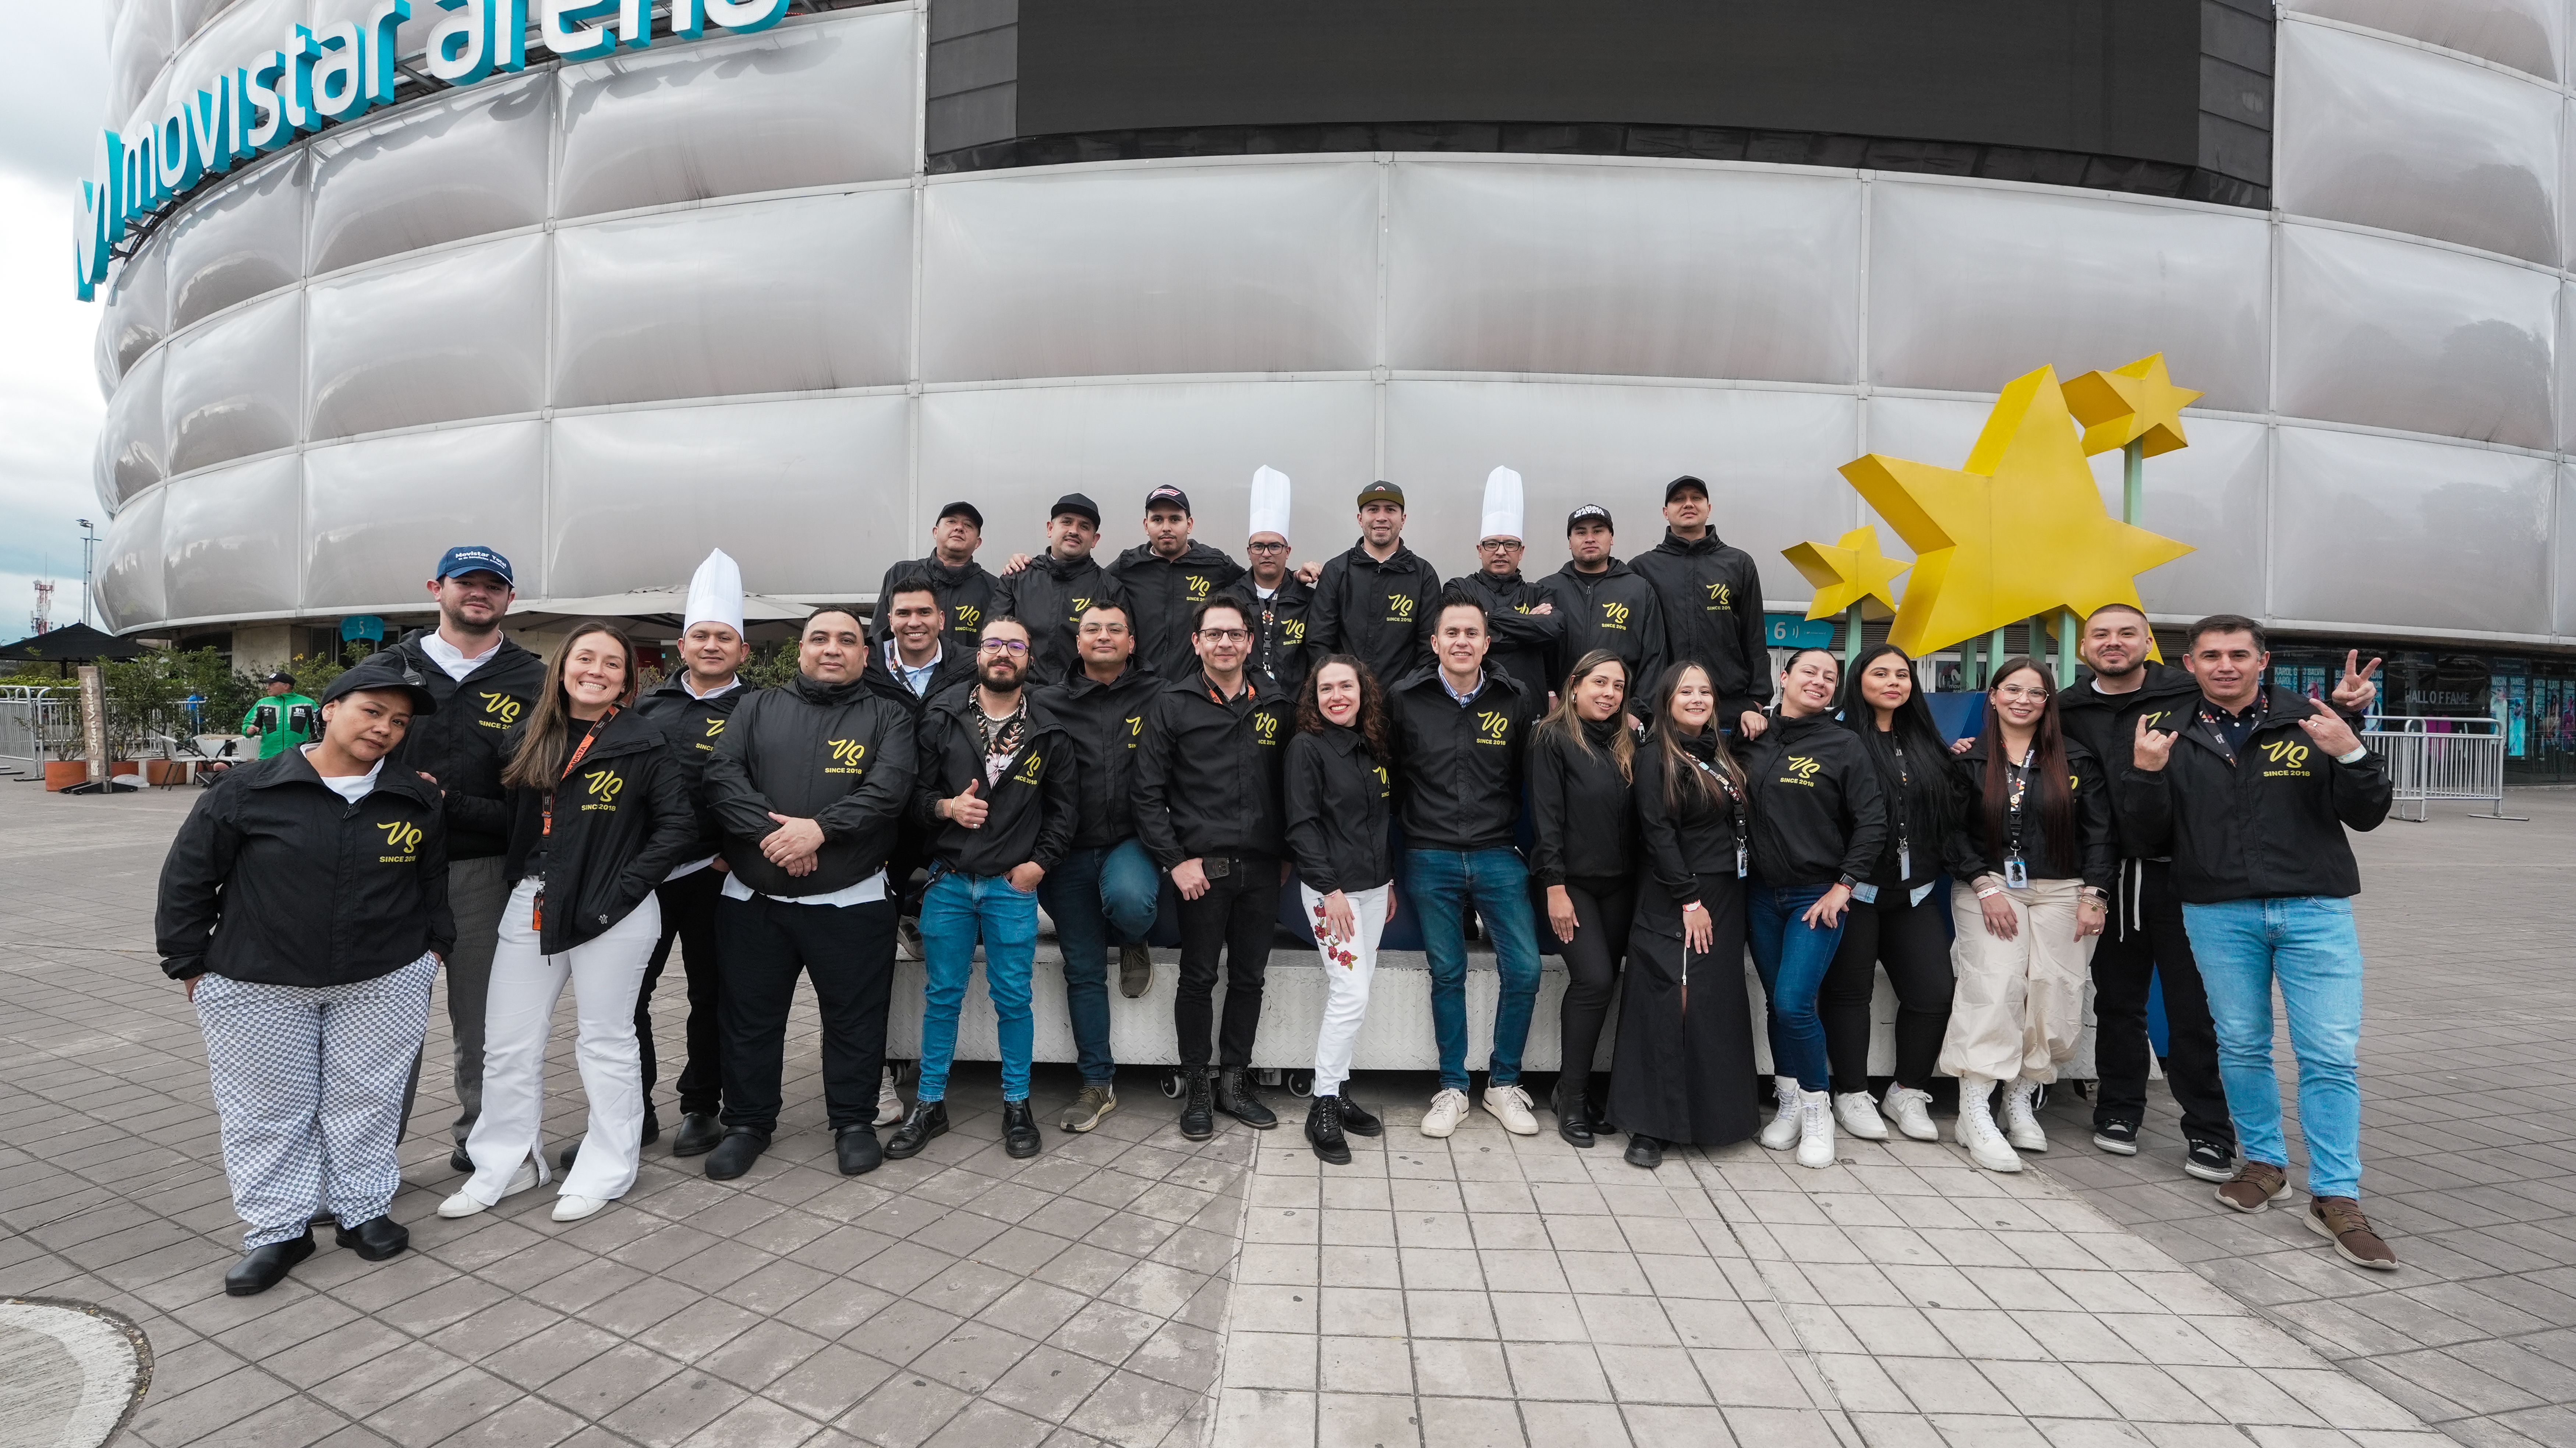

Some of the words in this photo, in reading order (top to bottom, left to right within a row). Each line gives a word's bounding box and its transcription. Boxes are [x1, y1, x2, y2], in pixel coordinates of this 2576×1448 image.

[121, 0, 411, 222] movistar
[492, 555, 507, 568] Total
[1185, 575, 1210, 597] VS
[1706, 583, 1730, 604] VS
[955, 605, 980, 626] VS
[1072, 597, 1090, 612] V
[1388, 594, 1413, 617] VS
[1602, 602, 1629, 624] VS
[359, 621, 365, 635] 5
[1281, 619, 1305, 639] VS
[1774, 621, 1786, 640] 6
[2275, 667, 2292, 676] KAROL
[2293, 668, 2298, 676] G
[86, 675, 96, 720] Valdez
[480, 692, 520, 723] VS
[2405, 690, 2428, 704] HALL
[2445, 691, 2470, 705] FAME
[478, 720, 501, 729] SINCE
[706, 717, 725, 737] V
[1126, 717, 1144, 736] V
[1255, 712, 1277, 738] VS
[1477, 711, 1508, 738] VS
[89, 720, 99, 755] Juan
[828, 739, 864, 766] VS
[2261, 740, 2308, 768] VS
[1788, 755, 1820, 778] VS
[584, 770, 623, 802] VS
[377, 821, 422, 853] VS
